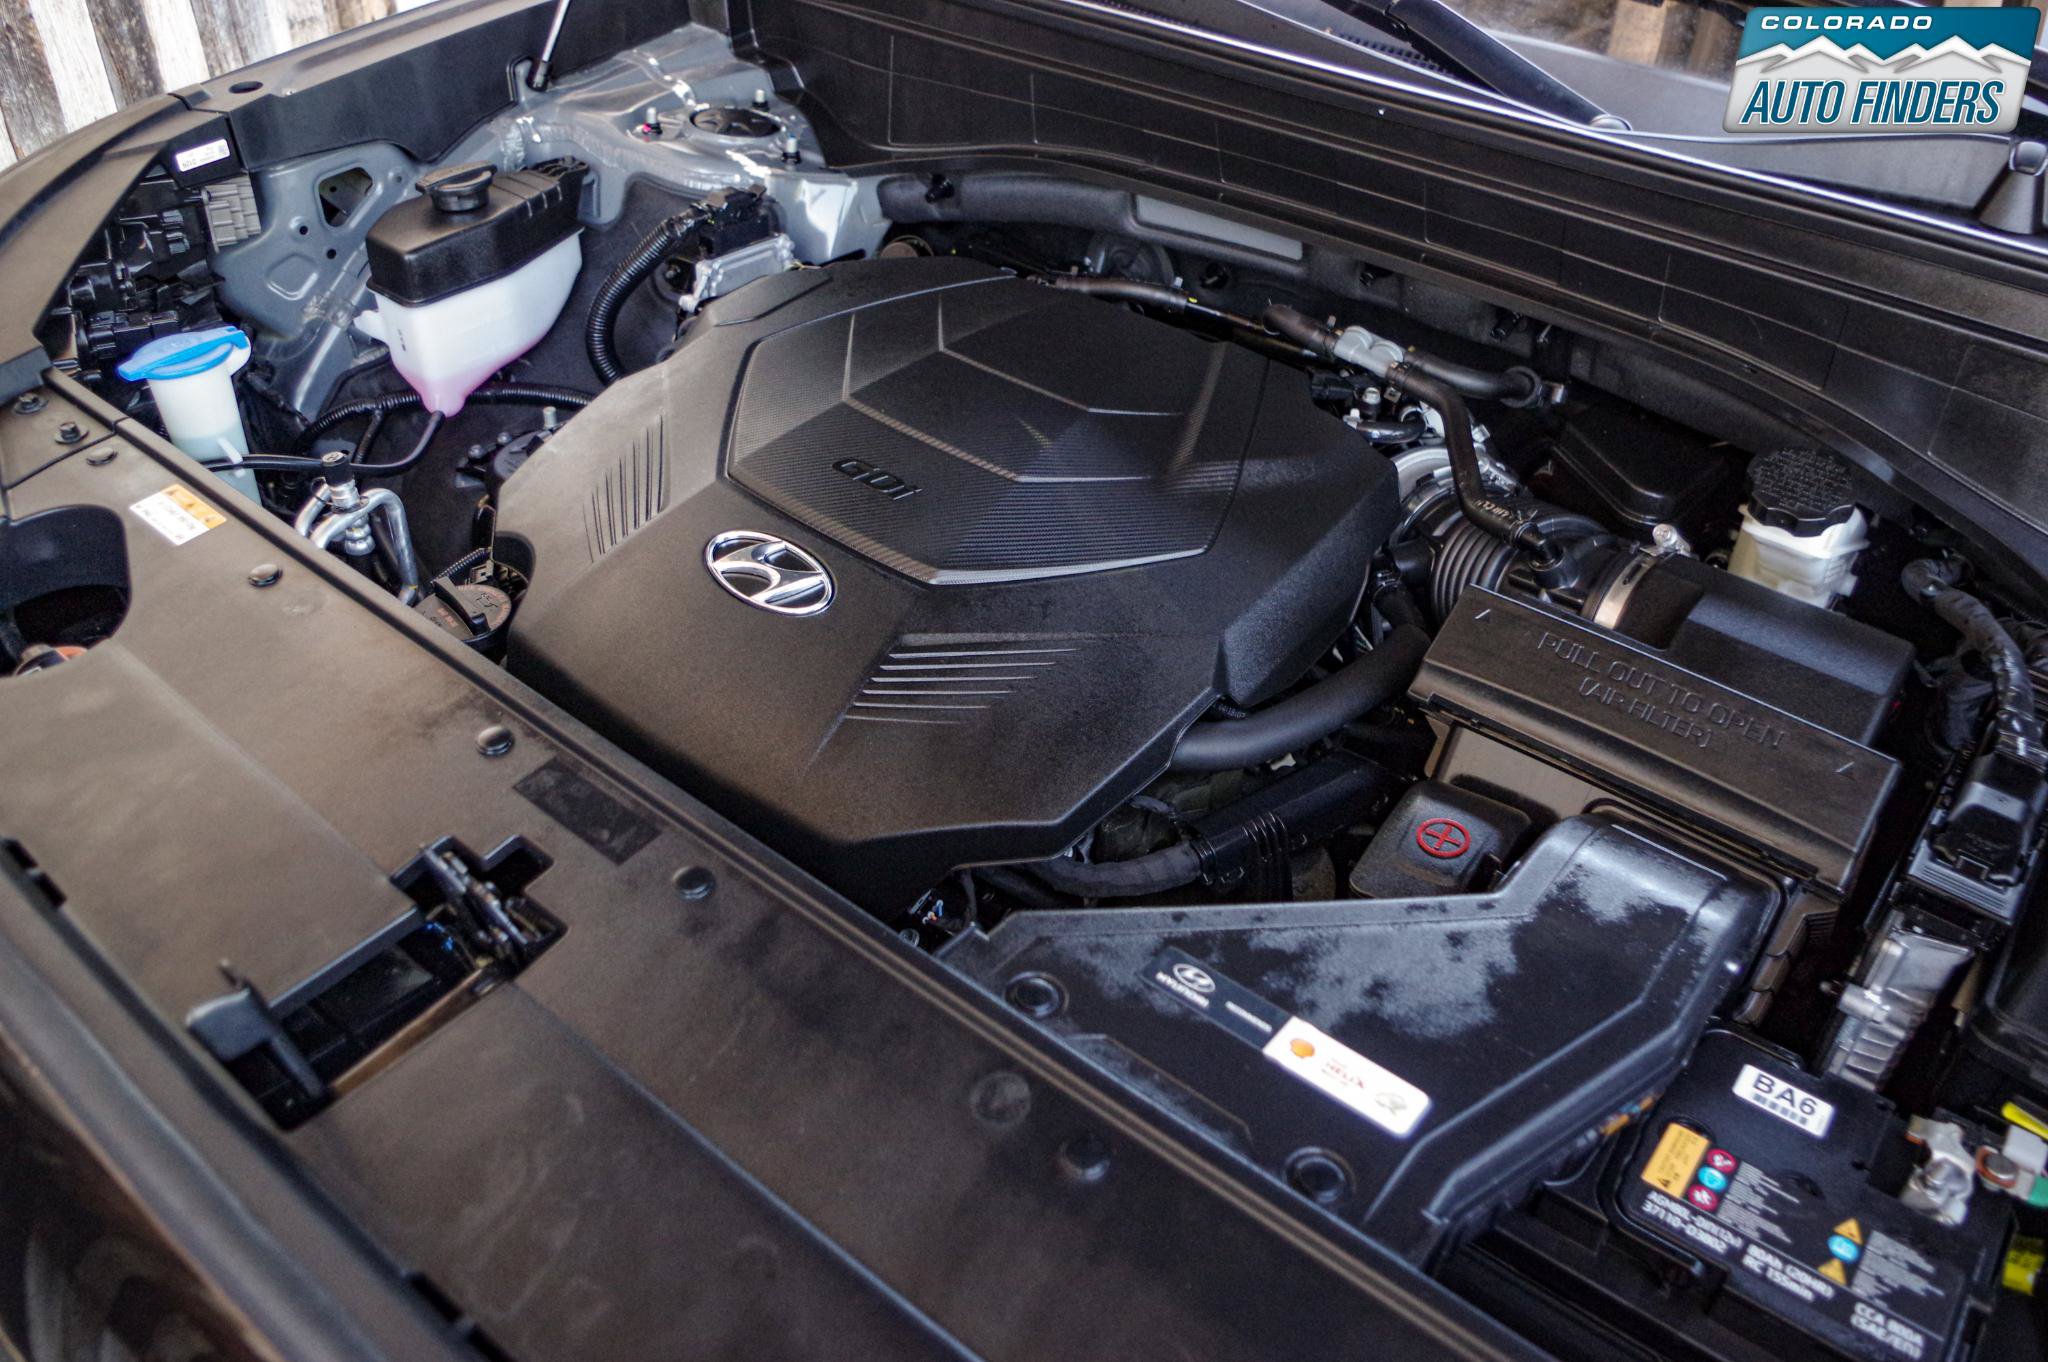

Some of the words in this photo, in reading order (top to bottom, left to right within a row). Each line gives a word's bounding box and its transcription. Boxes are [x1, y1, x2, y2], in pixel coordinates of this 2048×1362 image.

[1538, 632, 1602, 673] PULL
[1607, 661, 1667, 695] OUT
[1669, 683, 1704, 713] TO
[1706, 702, 1786, 747] OPEN
[1627, 698, 1712, 748] FILTER)
[1753, 1073, 1818, 1116] BA6
[1854, 1302, 1886, 1326] CCA
